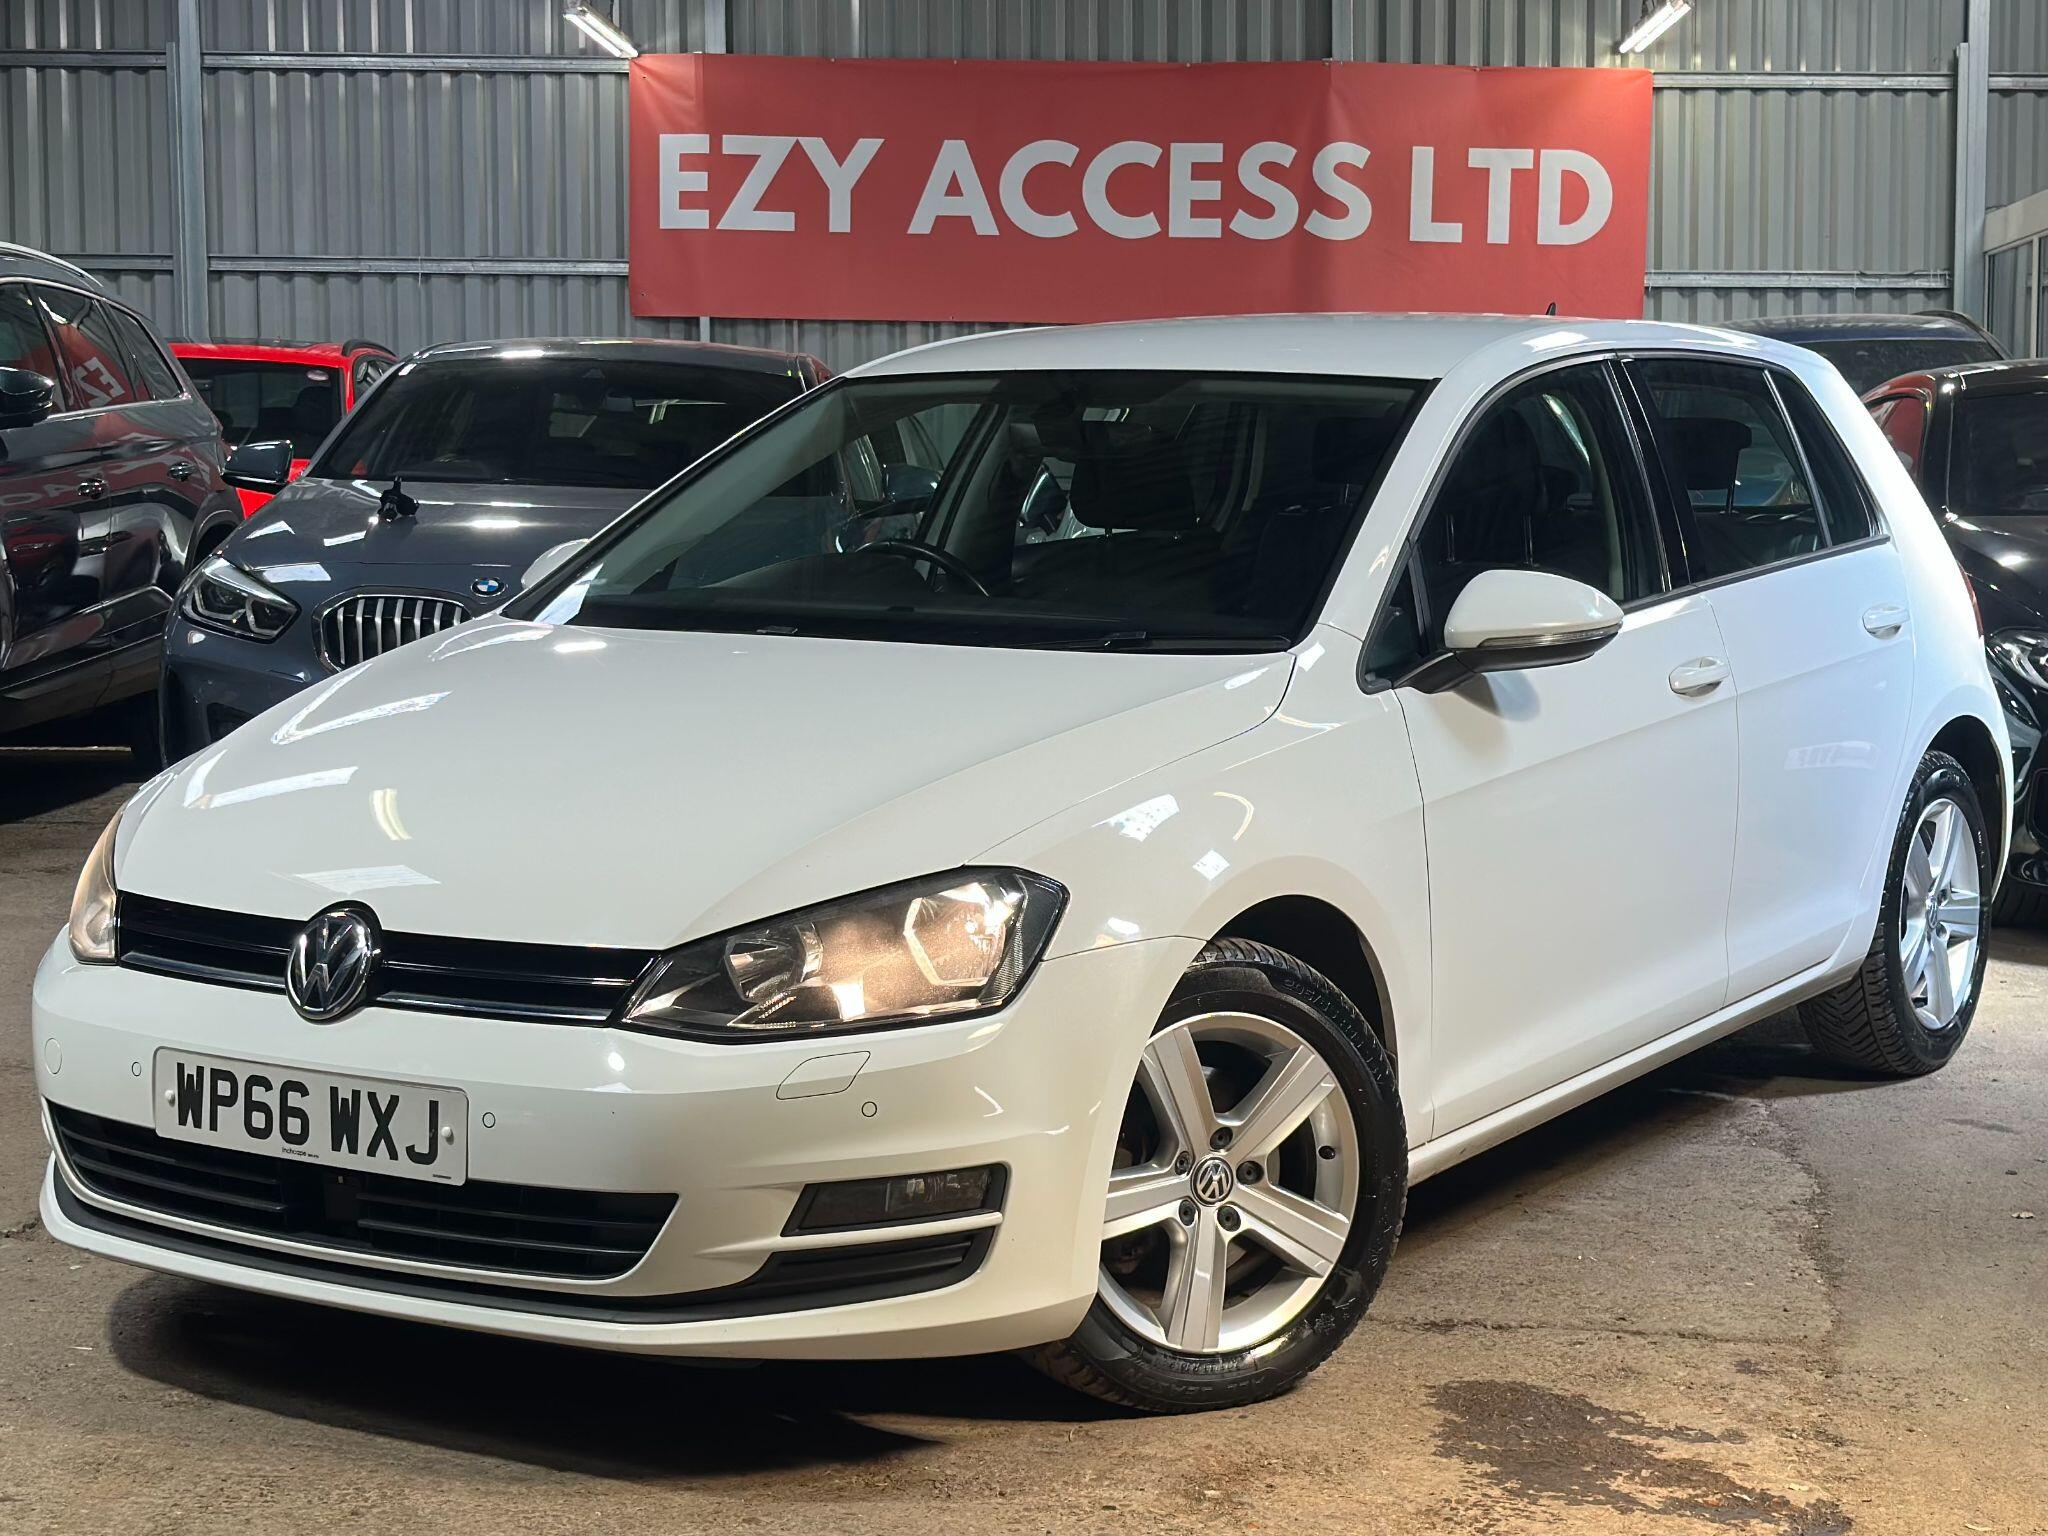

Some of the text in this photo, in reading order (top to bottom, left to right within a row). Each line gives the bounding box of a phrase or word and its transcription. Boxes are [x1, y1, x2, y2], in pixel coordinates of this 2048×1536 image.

[659, 133, 1613, 245] EZY ACCESS LTD
[176, 1062, 439, 1166] WP66 WXJ
